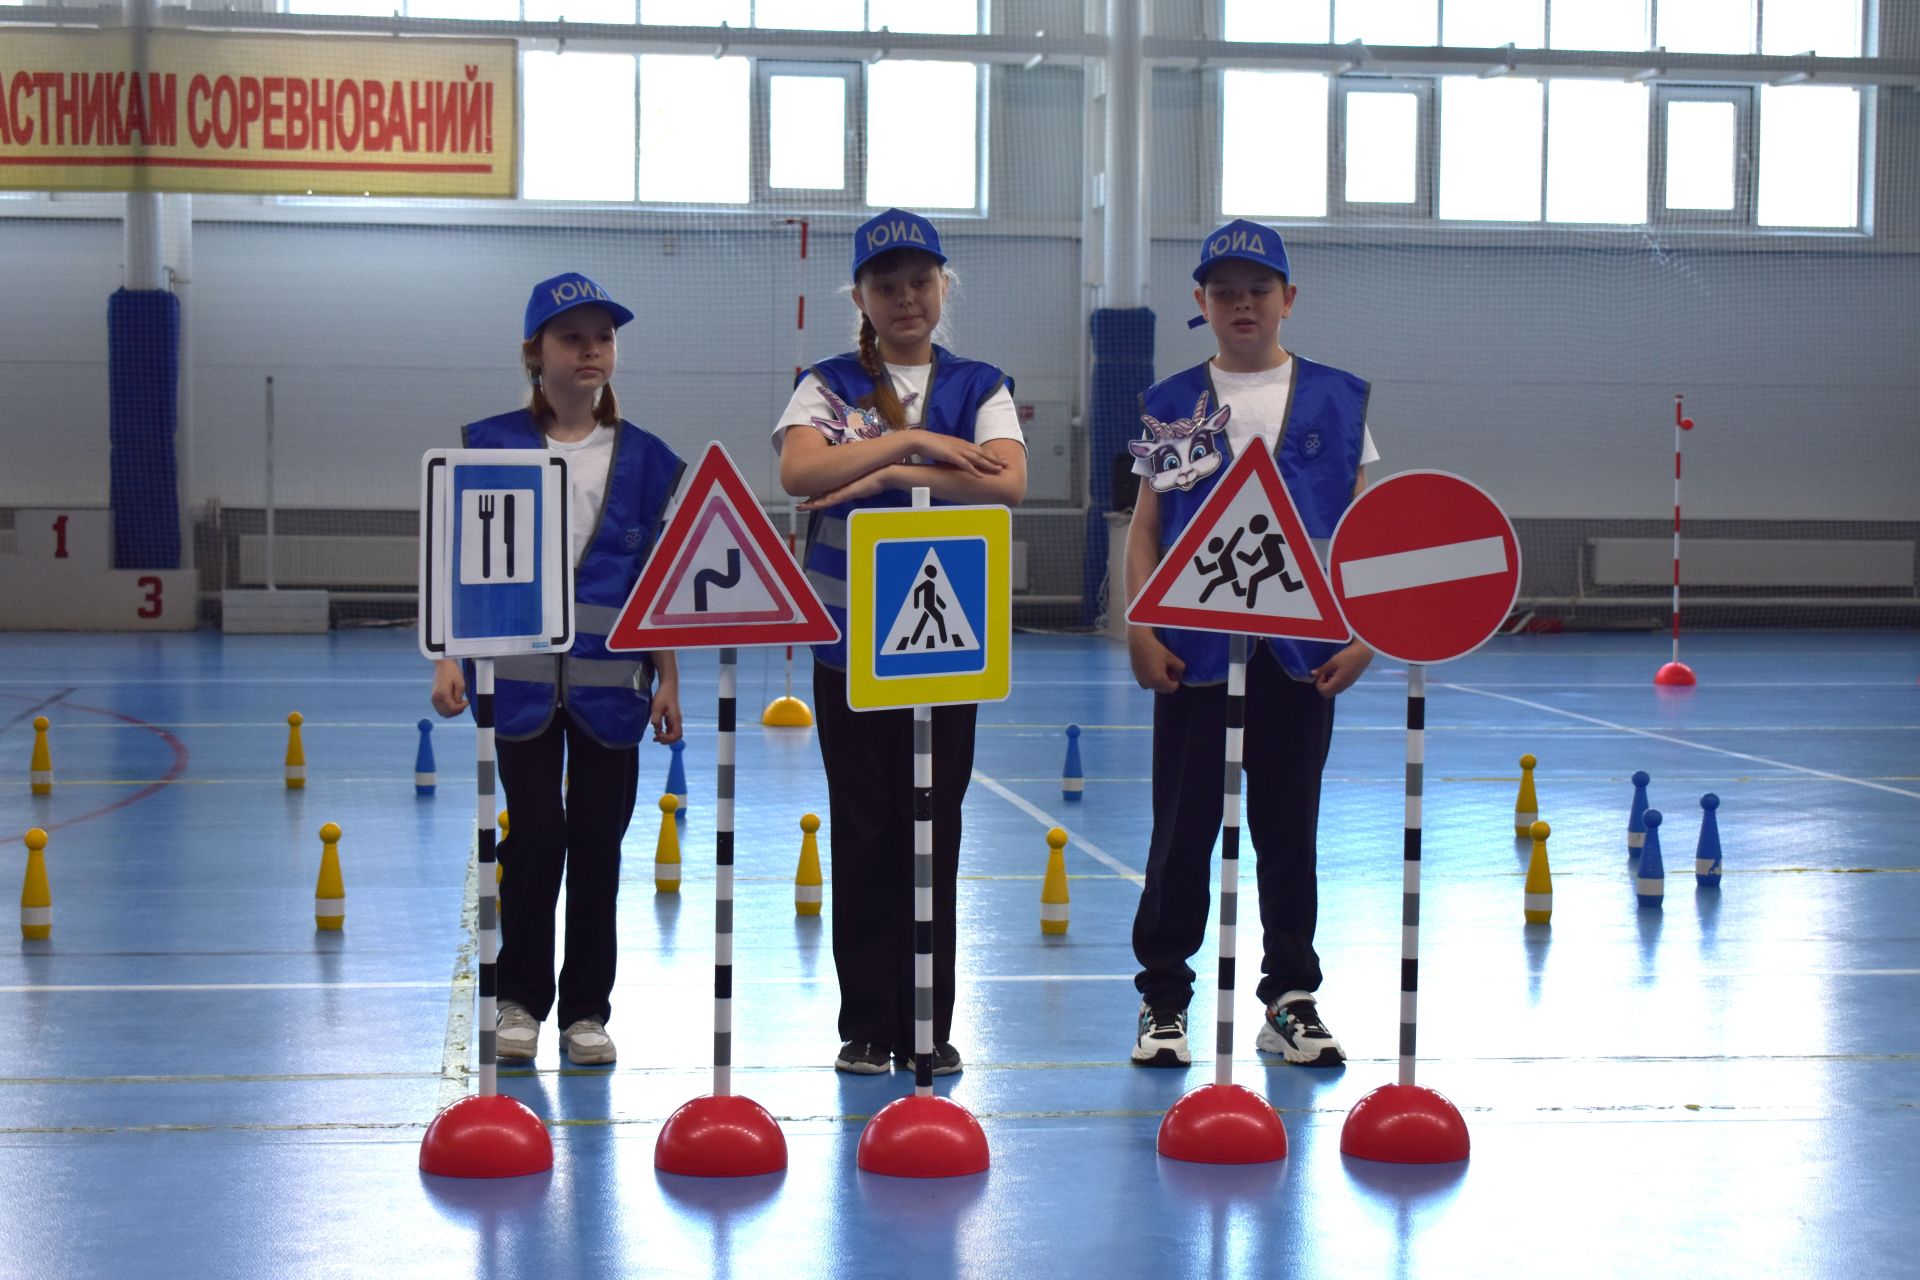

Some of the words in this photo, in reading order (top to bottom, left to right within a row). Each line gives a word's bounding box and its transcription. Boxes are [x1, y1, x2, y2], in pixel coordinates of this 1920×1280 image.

[187, 65, 493, 152] СОРЕВНОВАНИЙ!
[866, 220, 926, 251] ЮИД
[1209, 230, 1265, 257] ЮИД
[551, 281, 608, 305] ЮИД
[52, 515, 69, 558] 1
[137, 576, 163, 619] 3
